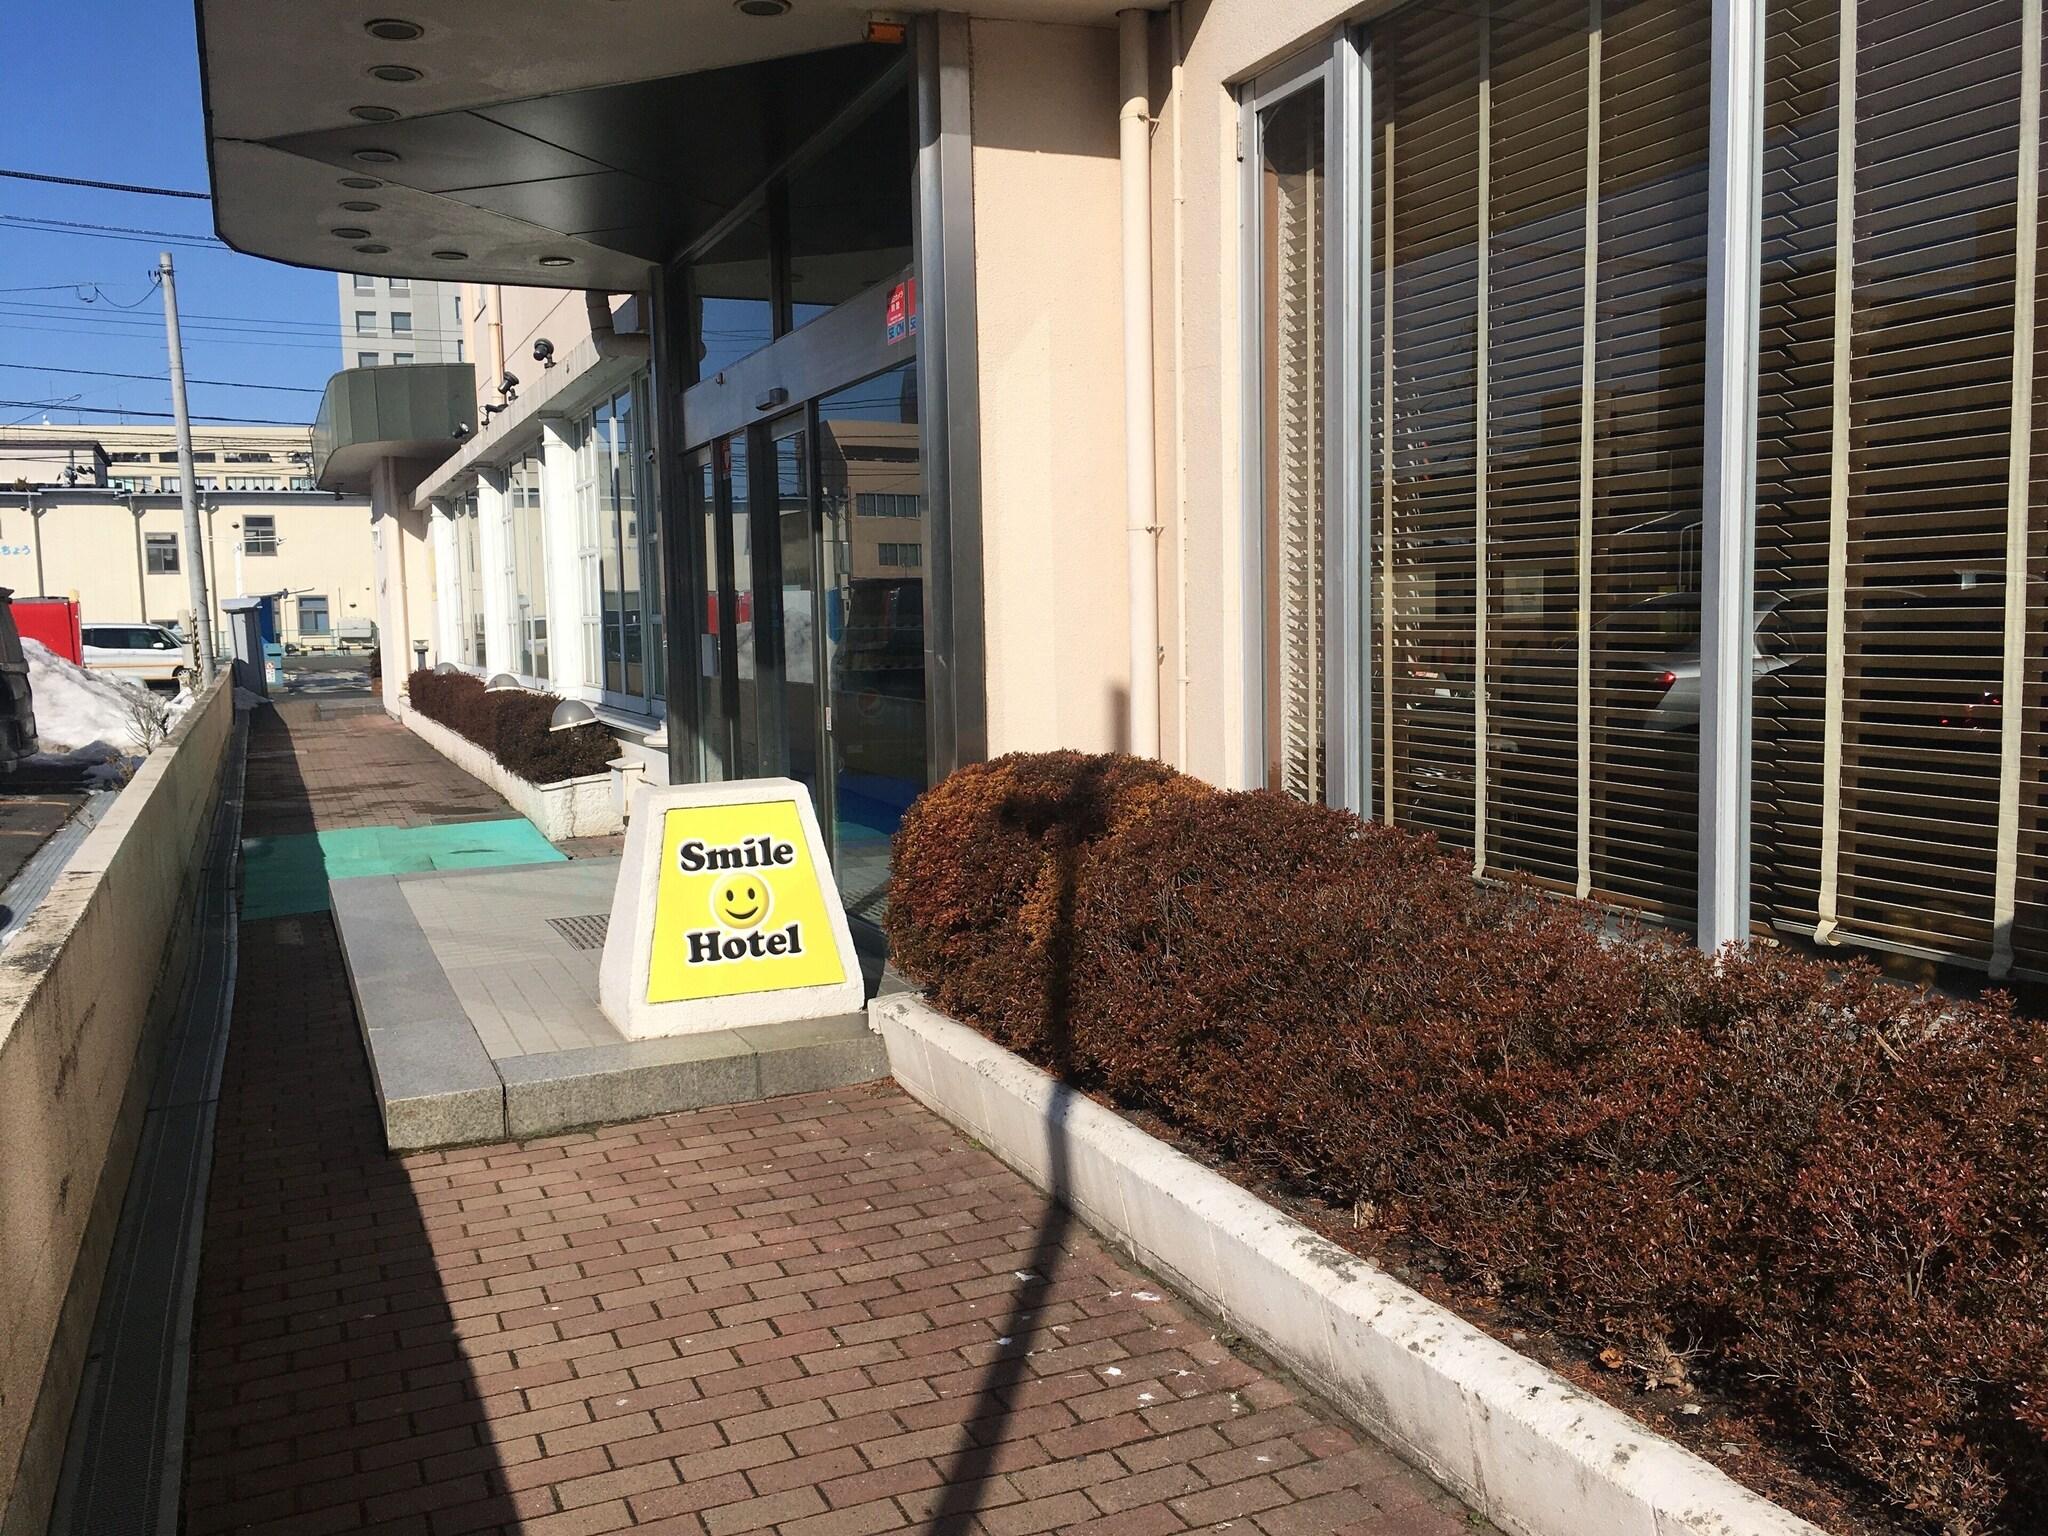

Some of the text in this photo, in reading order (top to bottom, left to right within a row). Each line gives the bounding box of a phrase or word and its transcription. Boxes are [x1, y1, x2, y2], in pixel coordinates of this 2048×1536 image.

[0, 544, 31, 556] ちょう
[680, 836, 794, 872] Smile
[686, 923, 802, 963] Hotel
